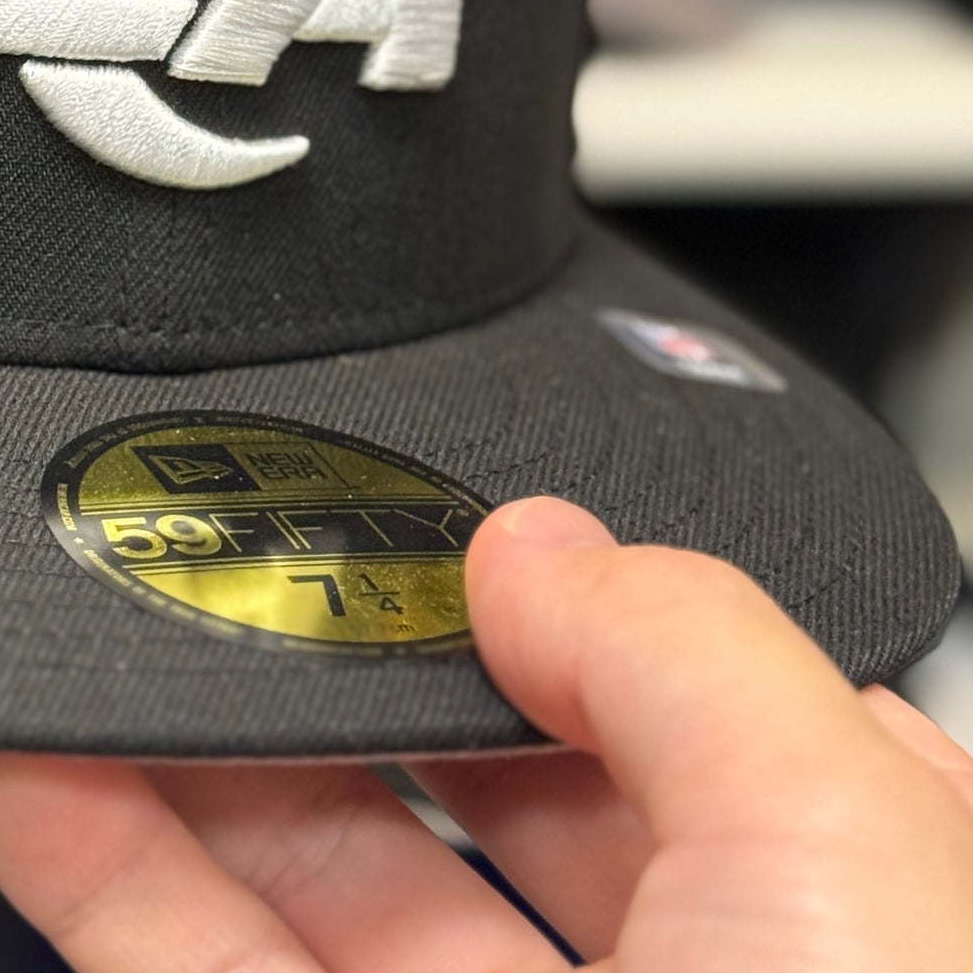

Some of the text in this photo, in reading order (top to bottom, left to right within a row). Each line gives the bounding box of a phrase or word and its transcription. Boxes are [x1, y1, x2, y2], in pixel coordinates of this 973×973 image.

[244, 451, 314, 467] NEW
[259, 465, 328, 480] ERA
[101, 508, 459, 559] 59FIFTY
[287, 574, 346, 617] 7
